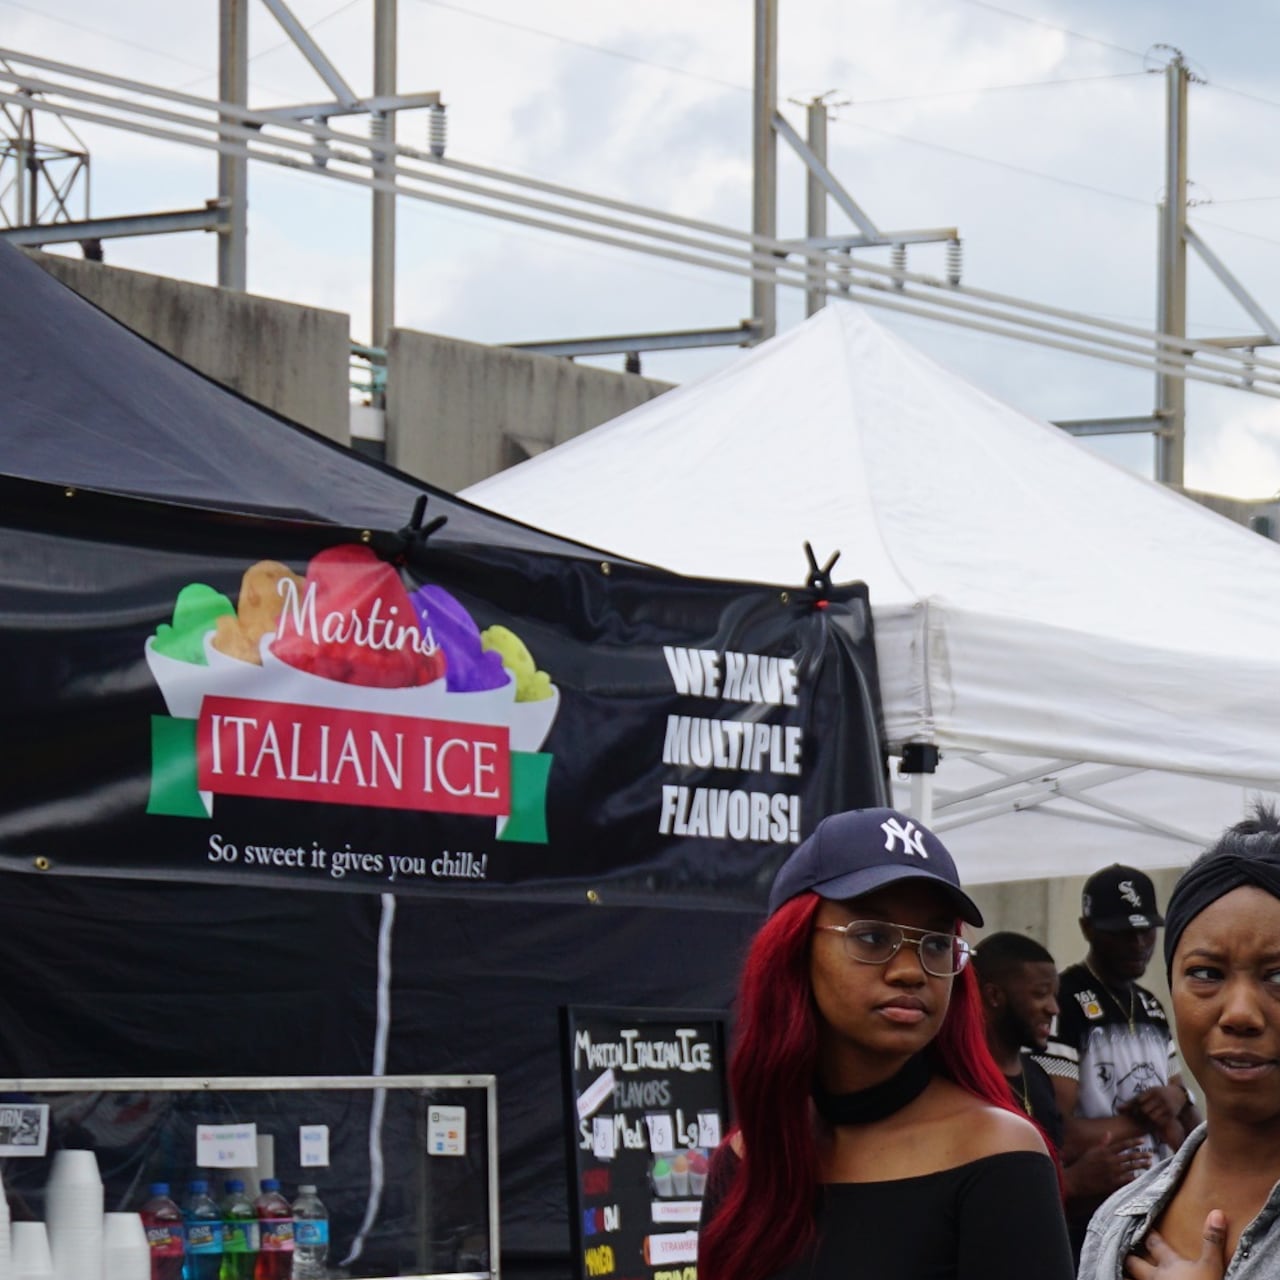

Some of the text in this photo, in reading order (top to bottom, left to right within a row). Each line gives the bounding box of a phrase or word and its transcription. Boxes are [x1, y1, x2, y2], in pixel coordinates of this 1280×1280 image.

[276, 576, 440, 656] Martin's
[663, 646, 799, 706] WE HAVE
[211, 714, 500, 798] ITALIAN ICE
[662, 714, 802, 775] MULTIPLE
[658, 785, 800, 844] FLAVORS!
[880, 817, 928, 859] NY
[208, 834, 488, 881] So sweet it gives you chills!
[613, 1080, 671, 1109] FLAVORS
[614, 1113, 647, 1150] Med
